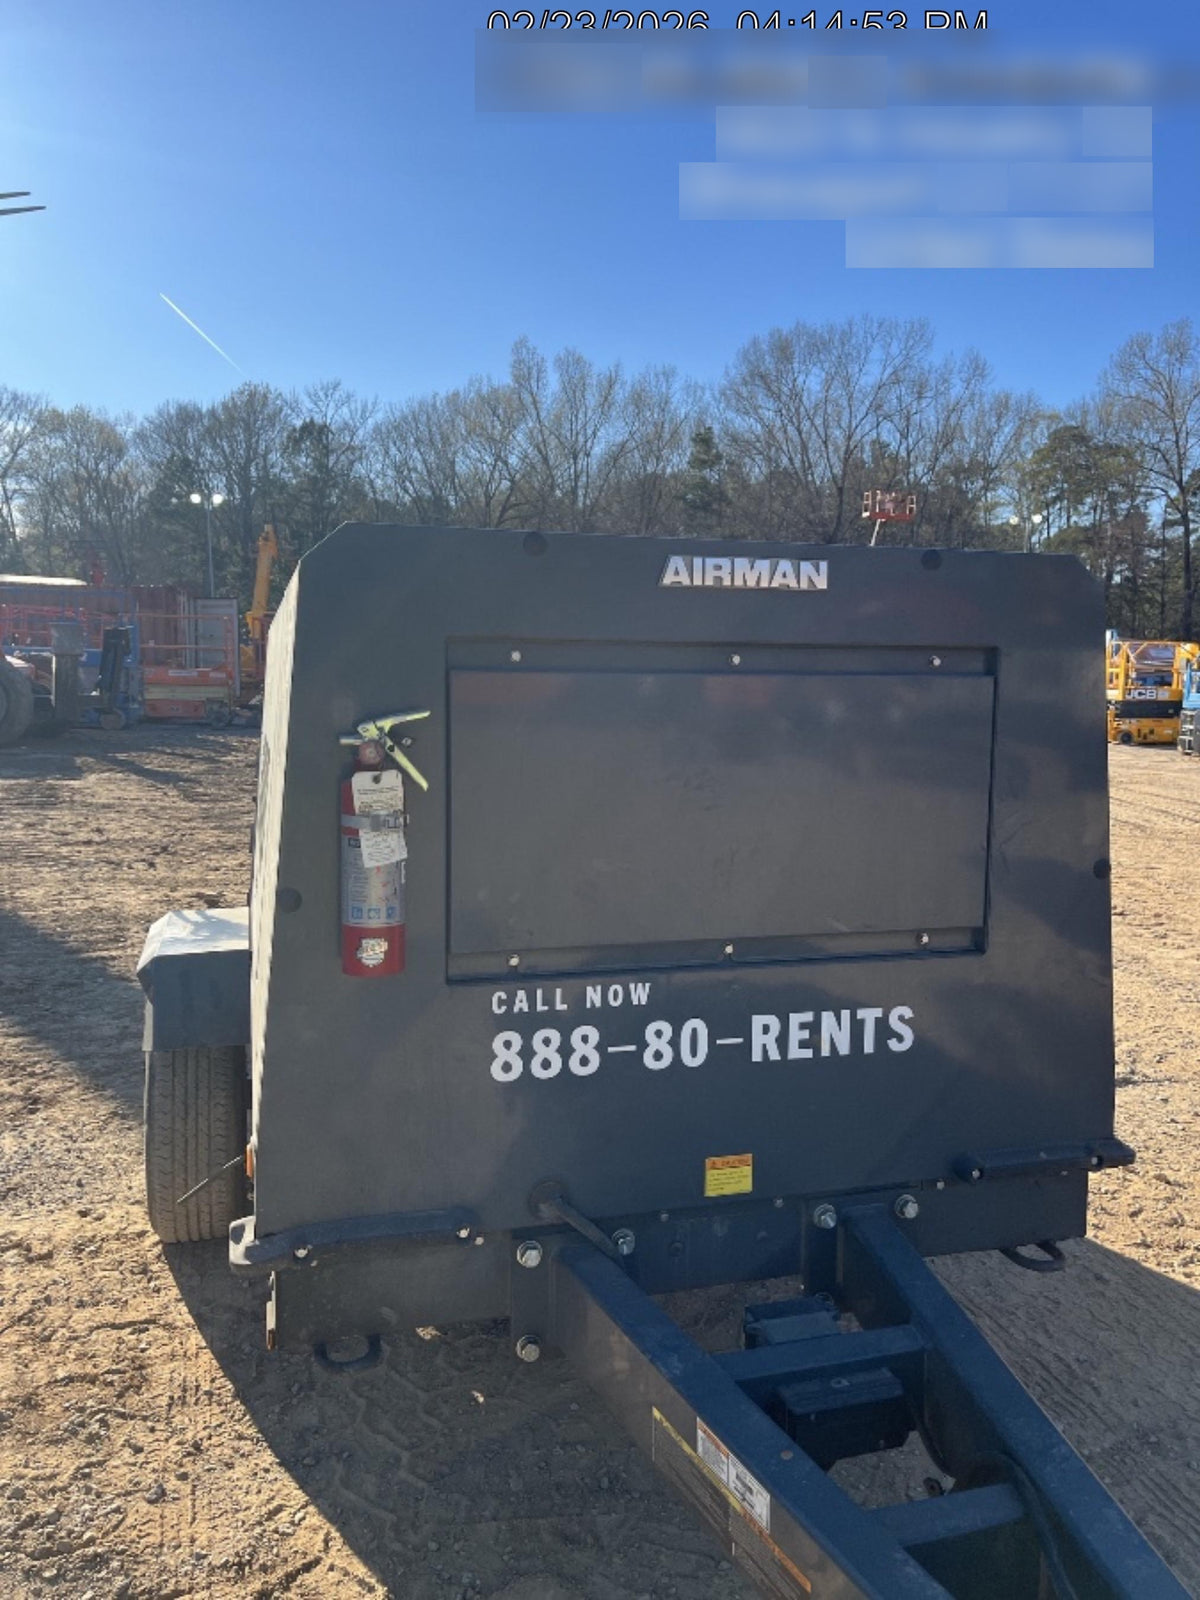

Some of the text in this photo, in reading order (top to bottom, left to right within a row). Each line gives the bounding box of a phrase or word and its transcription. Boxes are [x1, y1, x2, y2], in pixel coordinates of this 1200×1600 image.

[660, 555, 829, 591] AIRMAN
[1125, 689, 1157, 700] JCB
[491, 983, 651, 1015] CALL NOW
[490, 1005, 915, 1083] 888-80-RENTS
